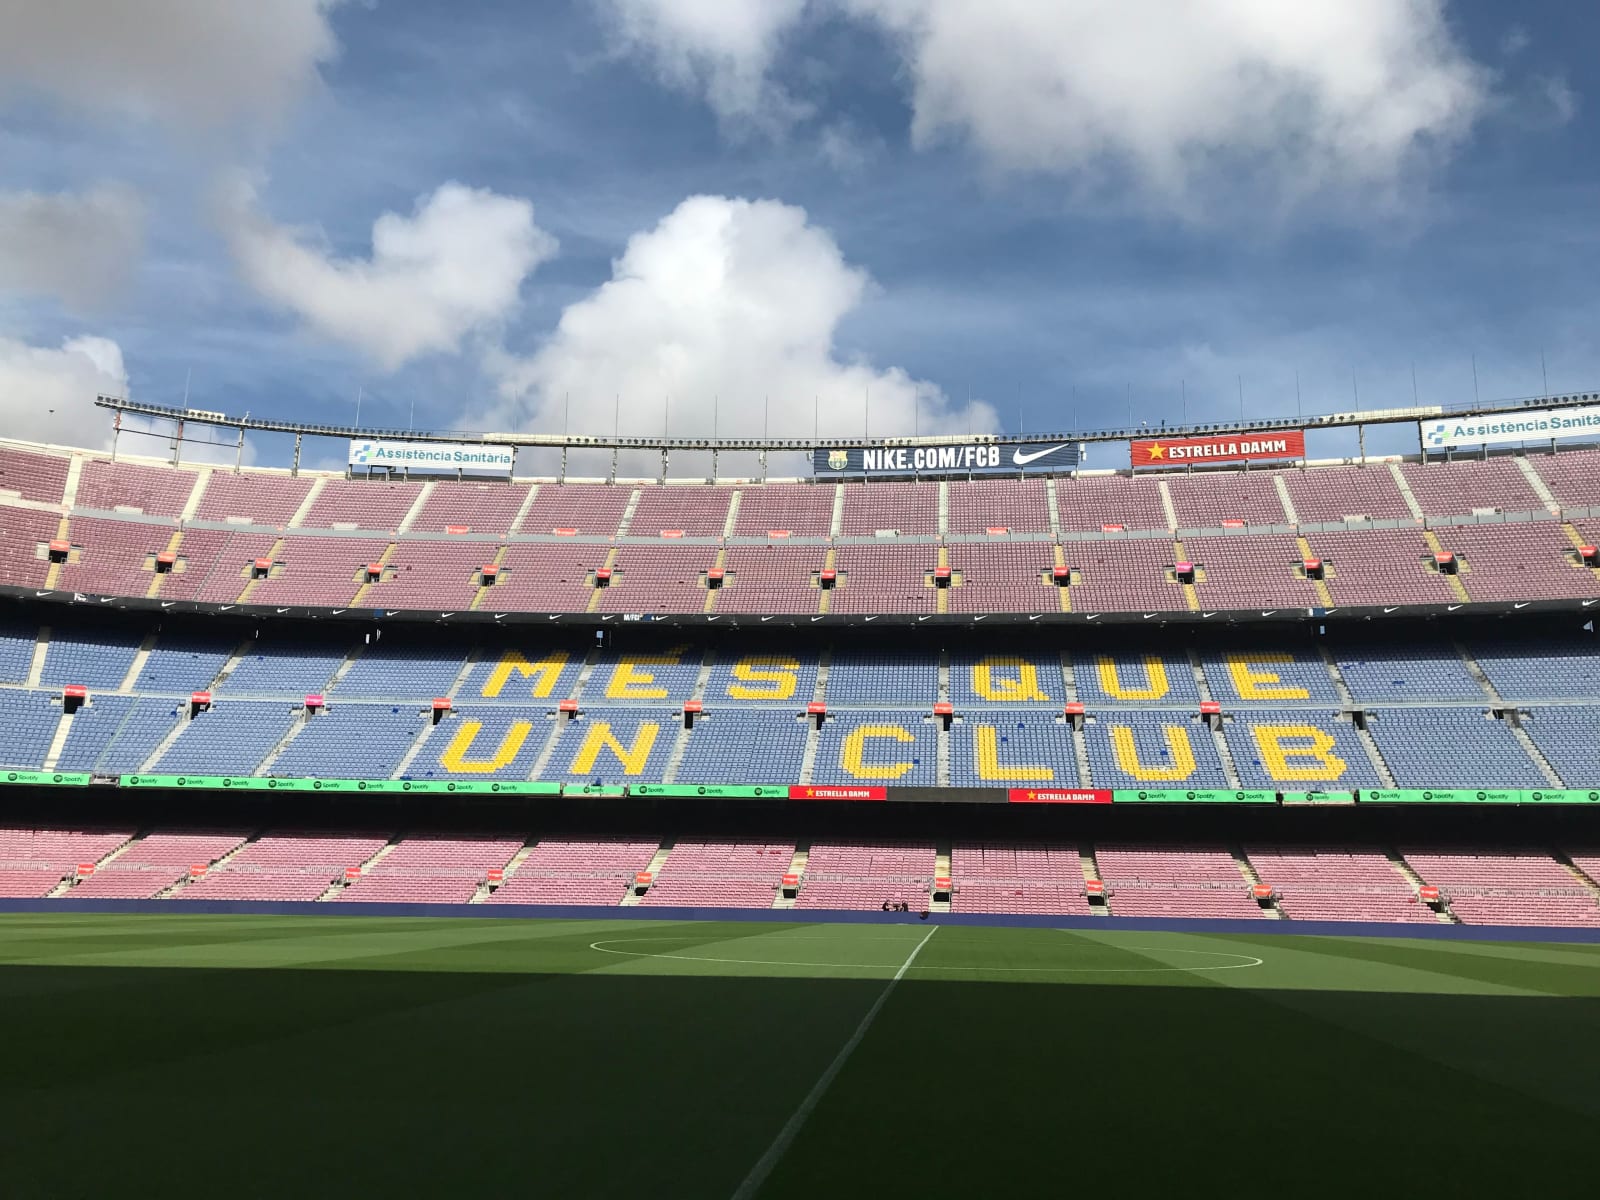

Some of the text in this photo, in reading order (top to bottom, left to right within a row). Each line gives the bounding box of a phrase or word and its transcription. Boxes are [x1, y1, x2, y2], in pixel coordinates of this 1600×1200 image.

[863, 446, 1000, 470] NIKE.COM/FCB
[1168, 439, 1287, 459] ESTRELLA DAMM
[973, 654, 1309, 701] QUE
[441, 721, 1347, 781] UN CLUB
[815, 789, 870, 798] ESTRELLA DAMM
[1037, 793, 1095, 801] ESTRELLA DAMM
